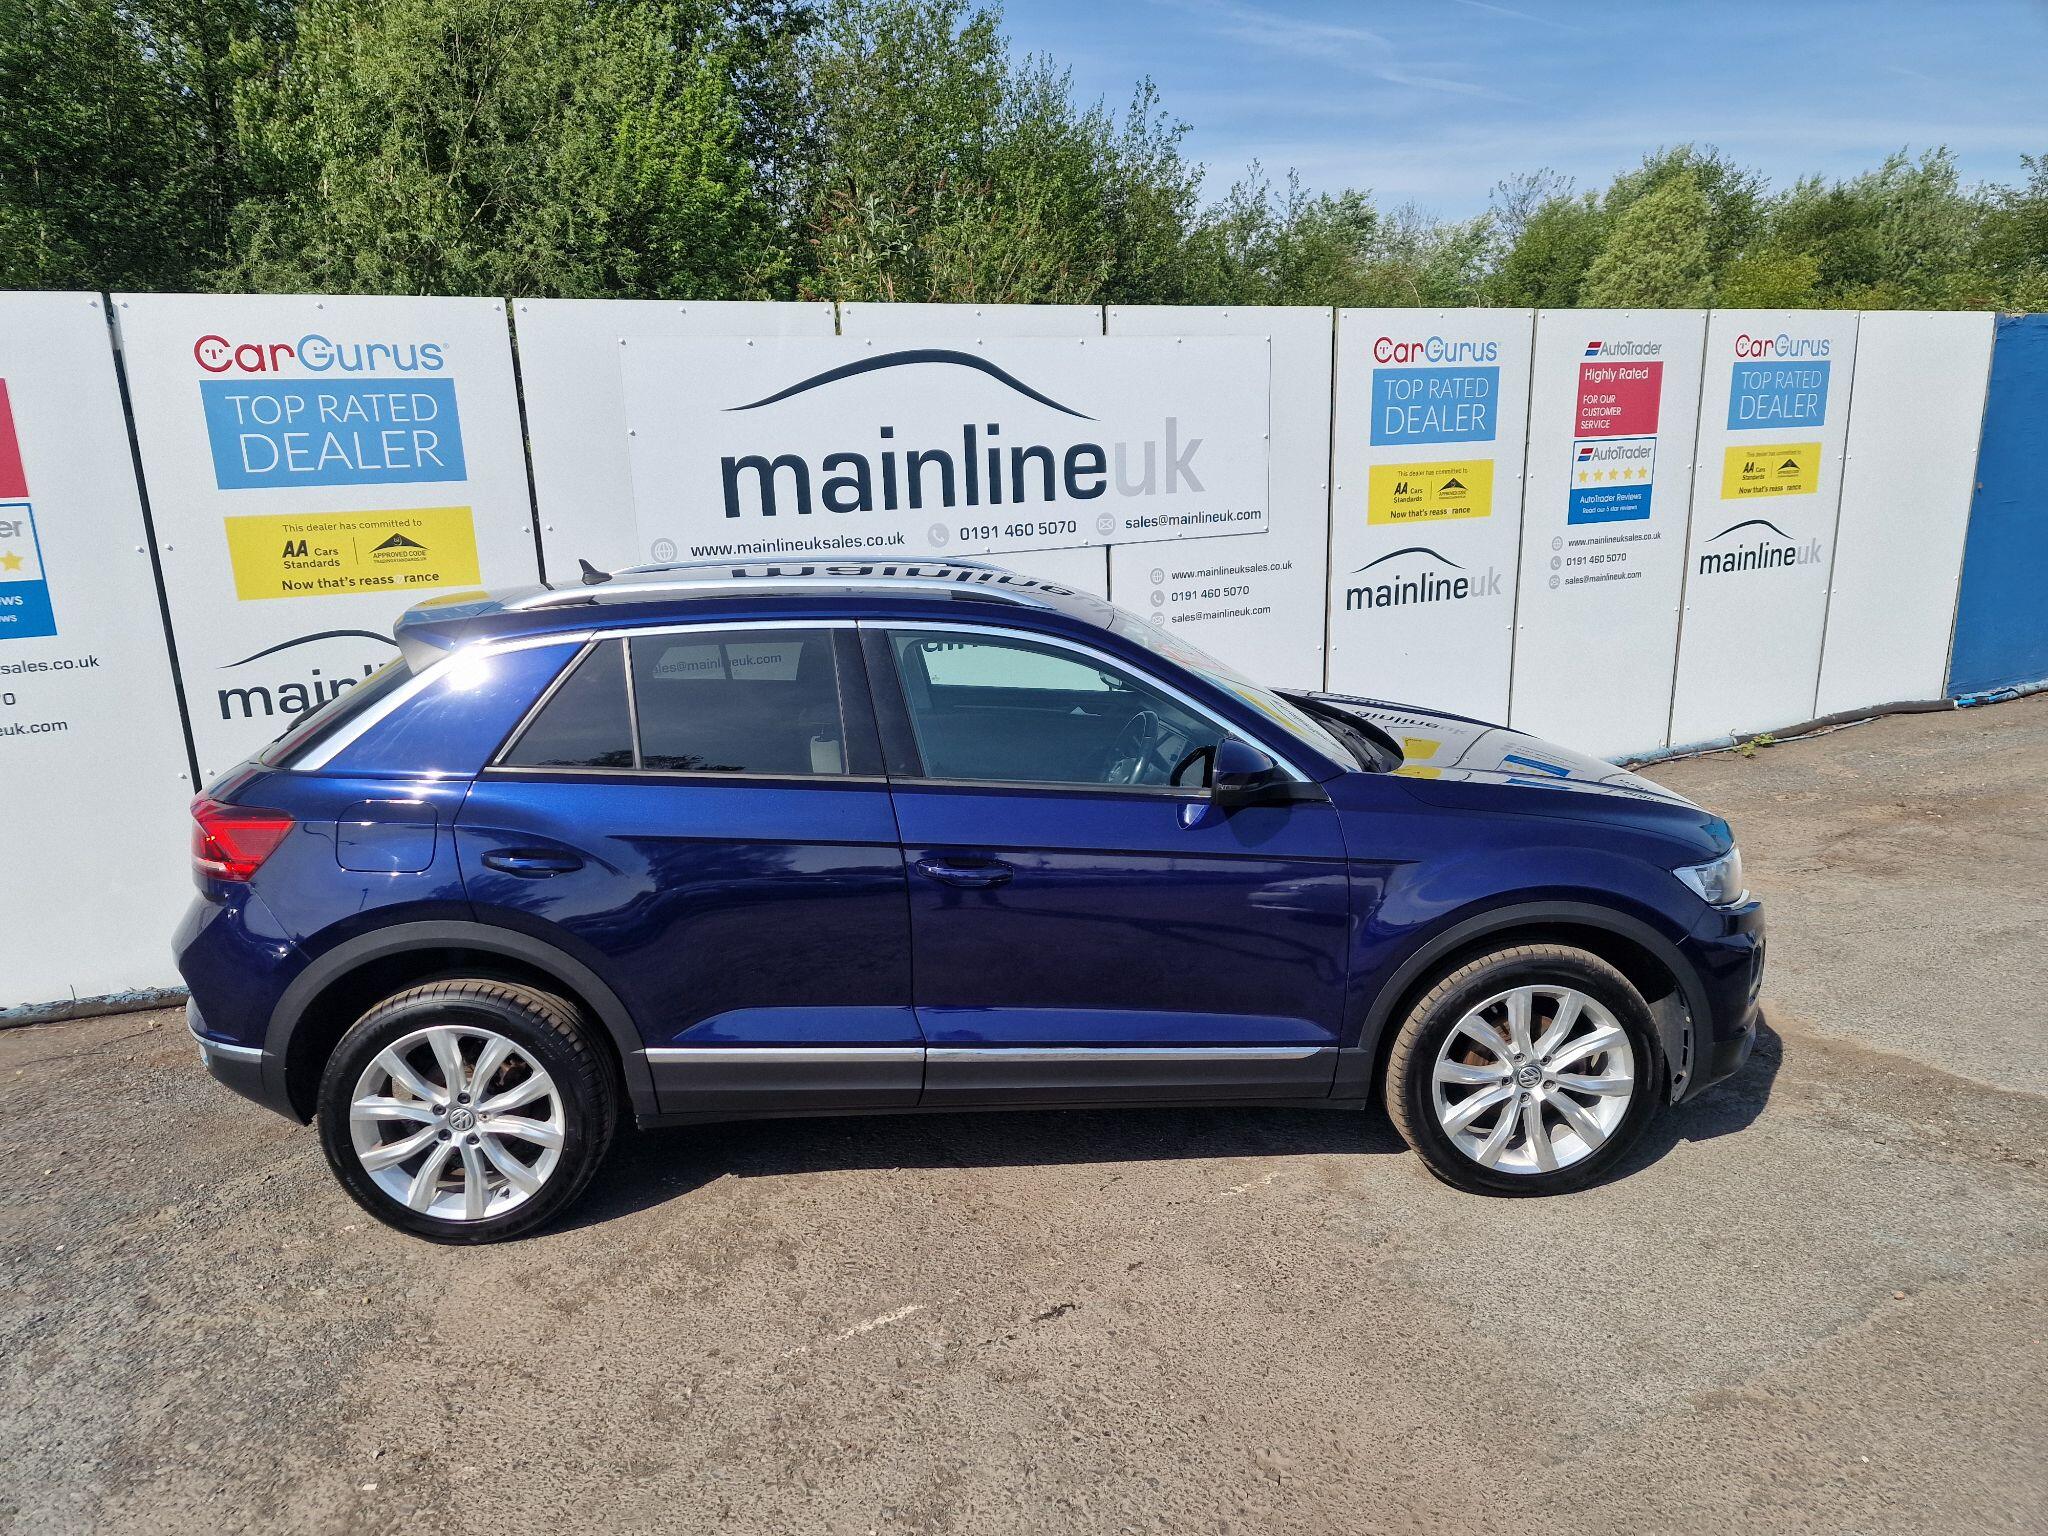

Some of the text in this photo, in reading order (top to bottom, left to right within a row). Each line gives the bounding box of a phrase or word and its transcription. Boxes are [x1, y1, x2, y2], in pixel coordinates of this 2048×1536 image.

[194, 334, 445, 373] CarGurus
[1373, 335, 1498, 363] CarGurus
[1600, 341, 1662, 356] AutoTrader
[1735, 333, 1830, 357] CarGurus
[1584, 367, 1649, 383] Highly Rated
[1741, 370, 1822, 390] TOP RATED
[1384, 377, 1489, 400] TOP RATED
[1583, 394, 1616, 404] FOR OUR
[1739, 393, 1818, 420] DEALER
[225, 393, 438, 425] TOP RATED
[1582, 406, 1622, 417] CUSTOMER
[1385, 403, 1486, 435] DEALER
[1580, 419, 1611, 429] SERVICE
[239, 429, 446, 473] DEALER
[1592, 445, 1651, 461] AutoTrader
[721, 416, 1205, 518] mainlineuk
[1743, 461, 1755, 473] AA
[1394, 481, 1408, 495] AA
[1738, 487, 1752, 495] Now
[1125, 508, 1262, 530] sales@mainlineuk.com
[1390, 510, 1406, 518] Now
[1408, 508, 1428, 517] that's
[282, 518, 422, 533] This dealer has committed to
[960, 520, 1077, 541] 0191 460 5070
[282, 539, 339, 558] AA Cars
[690, 532, 906, 557] www.mainlineuksales.co.uk
[1568, 531, 1662, 547] www.mainlineuksales.co.uk
[283, 558, 341, 570] Standards
[373, 551, 407, 559] APPROVED
[1566, 552, 1627, 567] 0191 460 5070
[1699, 537, 1823, 575] mainlineuk
[1171, 560, 1293, 580] www.mainlineuksales.co.uk
[281, 579, 314, 591] Now
[317, 576, 356, 589] that's
[1346, 566, 1502, 611] mainlineuk
[1171, 585, 1250, 602] 0191 460 5070
[1171, 605, 1271, 624] sales@mainlineuk.com
[0, 655, 100, 675] sales.co.uk
